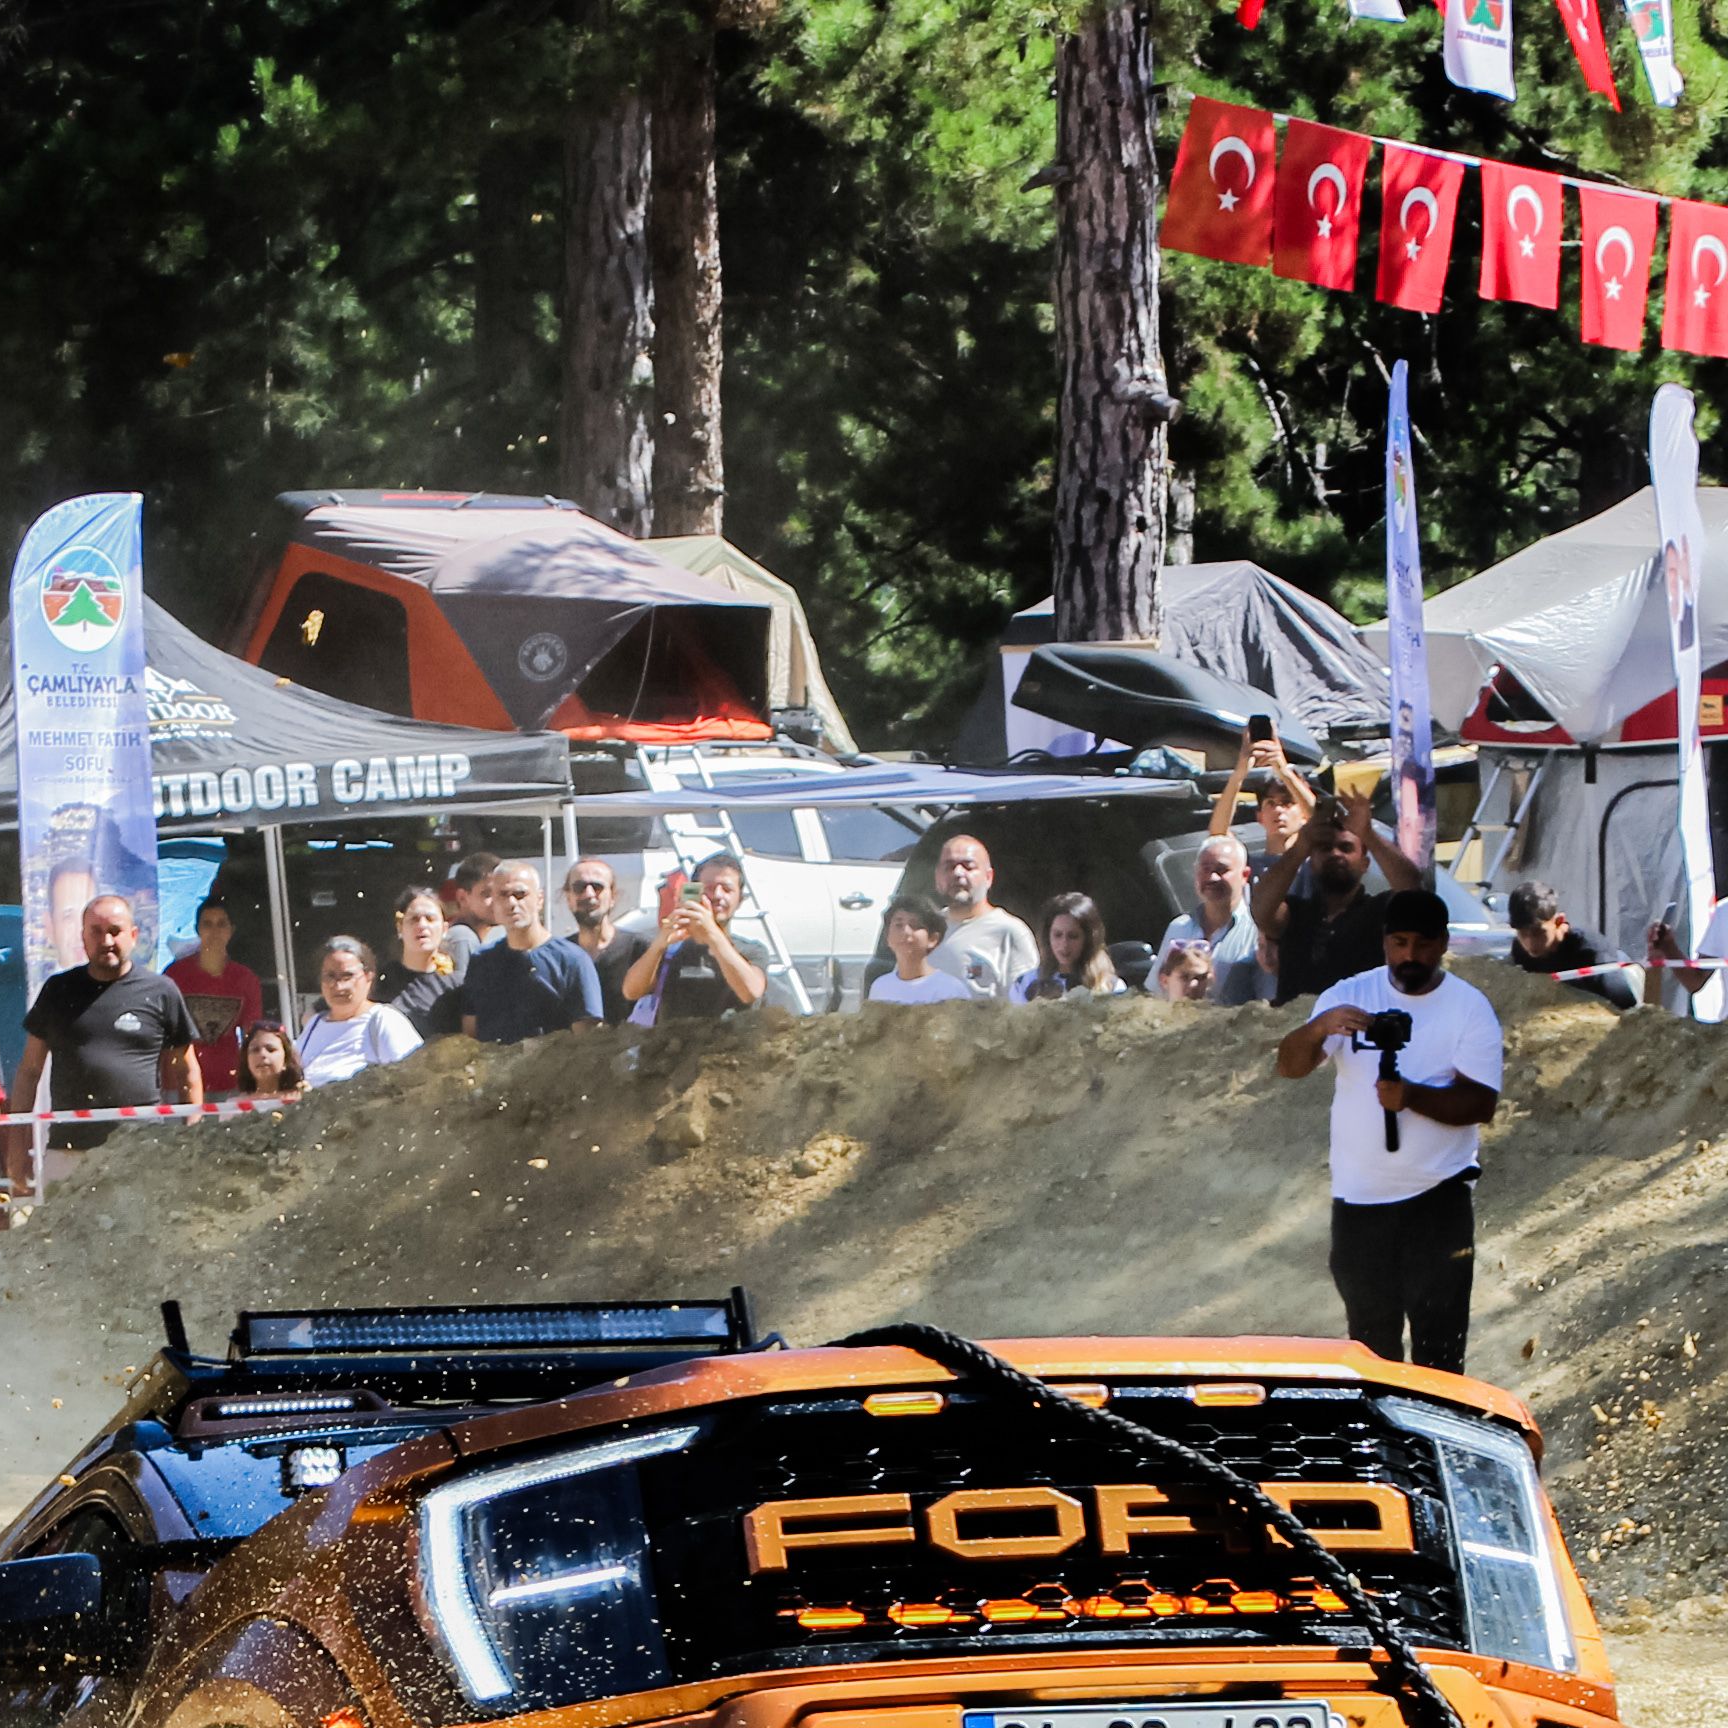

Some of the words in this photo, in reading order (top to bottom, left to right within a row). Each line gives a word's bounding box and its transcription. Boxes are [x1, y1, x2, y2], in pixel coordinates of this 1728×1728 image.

[28, 731, 93, 747] MEHMET
[65, 756, 104, 771] SOFU
[153, 763, 319, 818] TDOOR
[331, 753, 471, 804] CAMP
